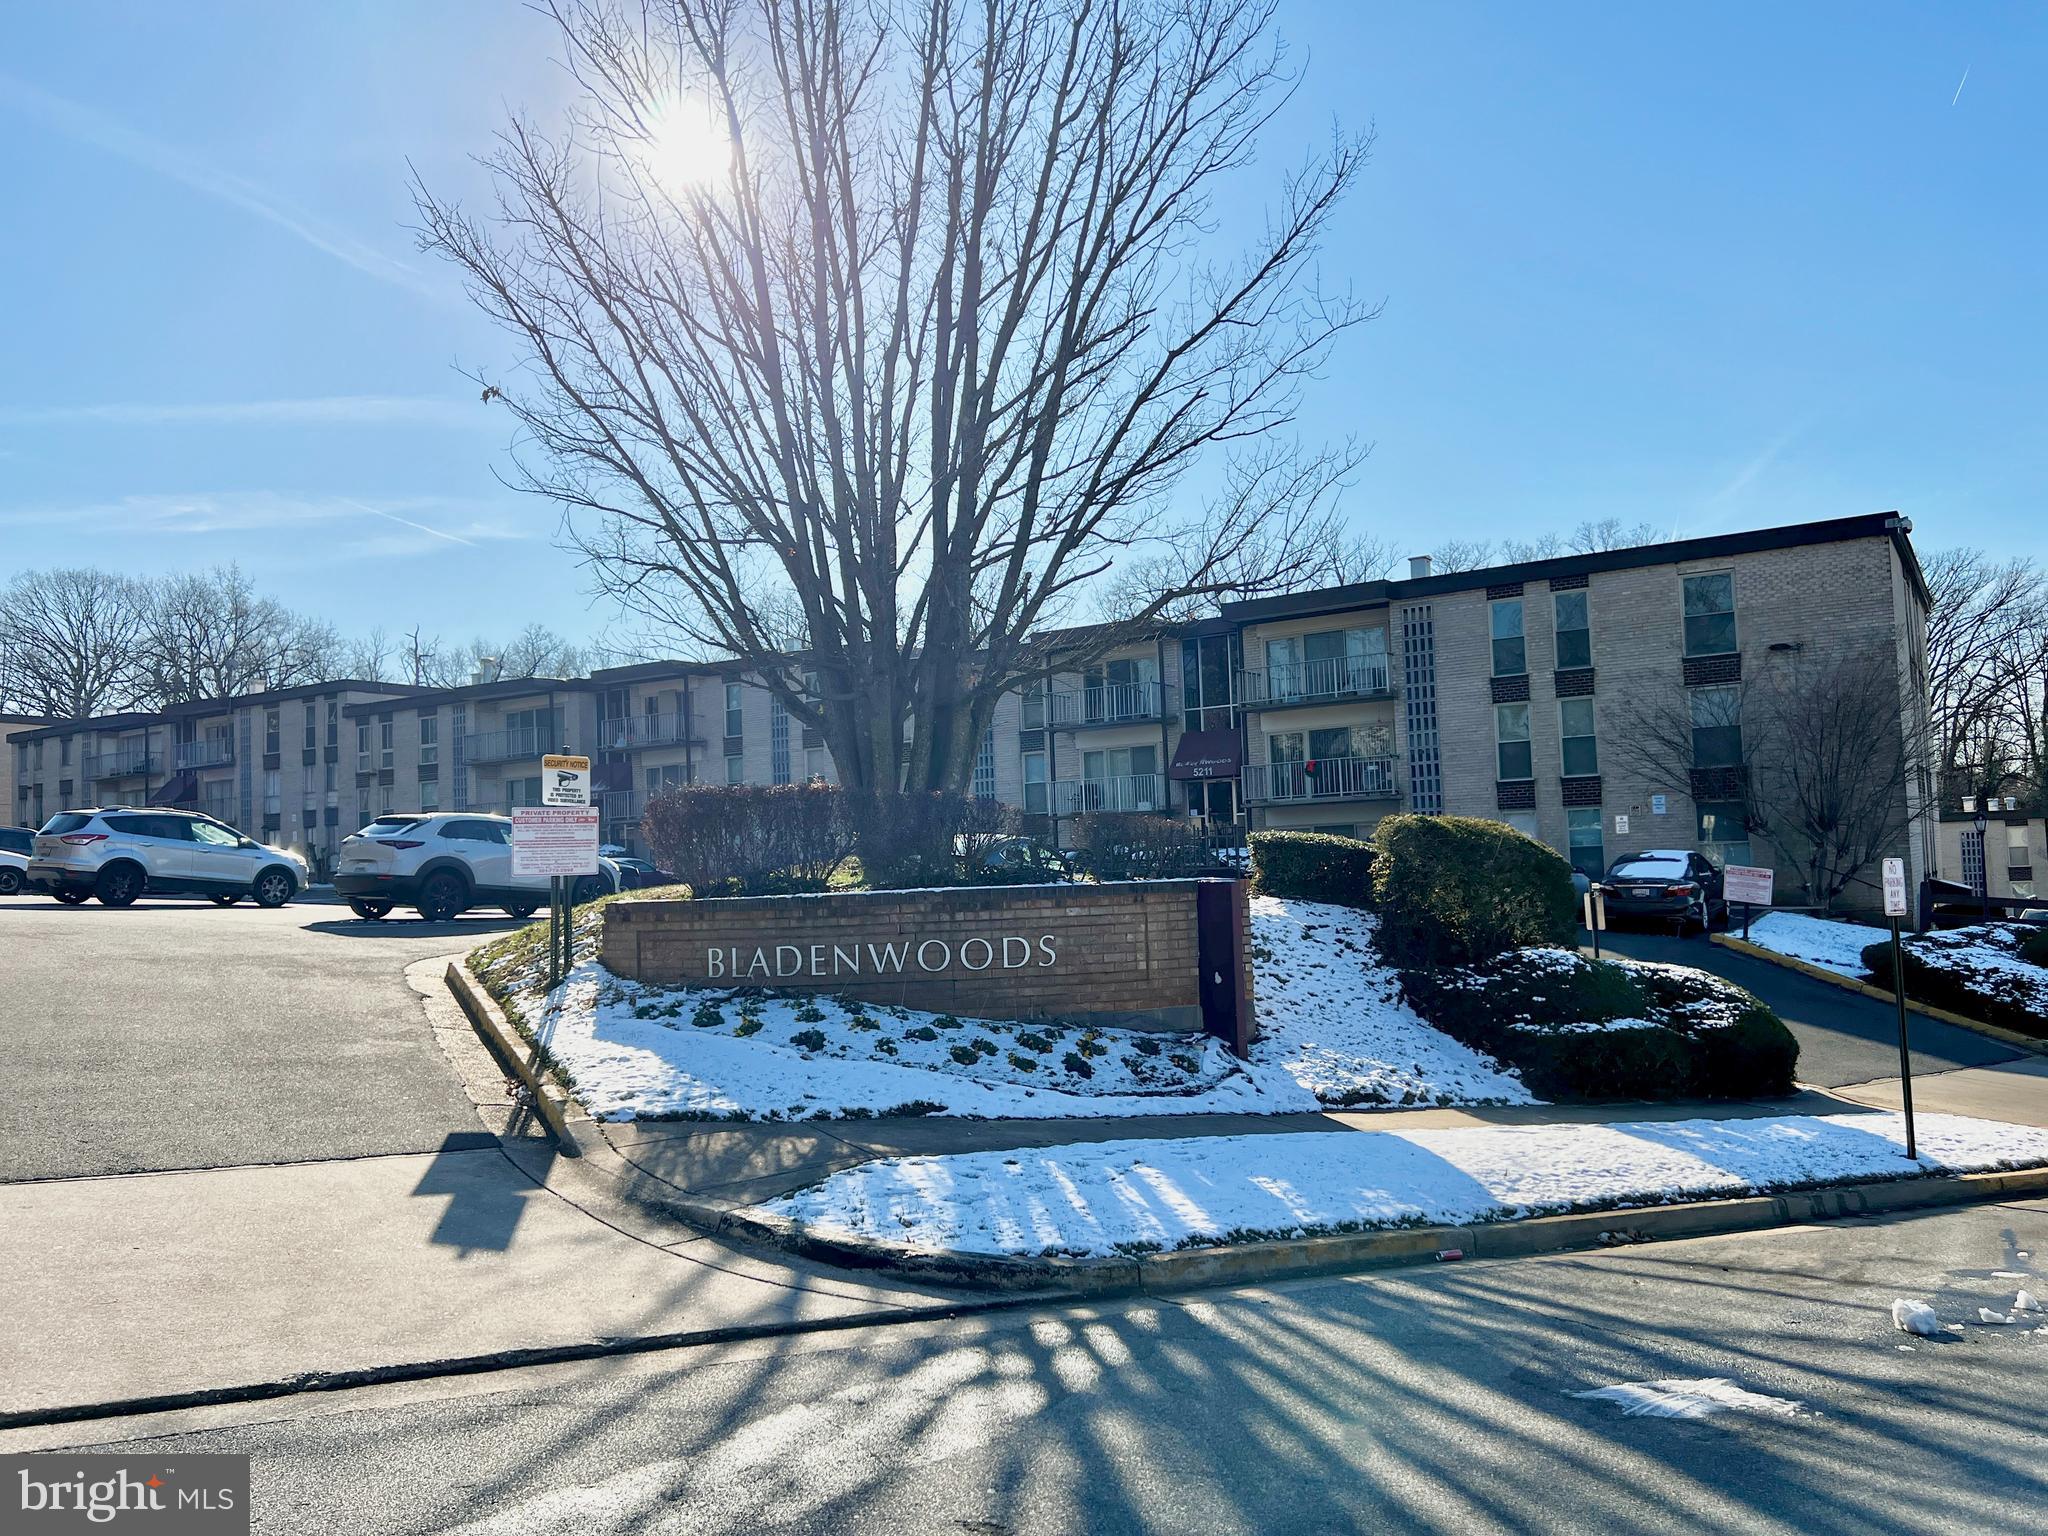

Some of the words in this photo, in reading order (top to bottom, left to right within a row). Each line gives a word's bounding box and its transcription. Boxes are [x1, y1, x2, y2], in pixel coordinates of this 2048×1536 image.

[544, 759, 569, 768] SECURITY
[570, 761, 588, 769] NOTICE
[1193, 767, 1213, 776] 5211
[1888, 864, 1897, 875] NO
[1884, 876, 1904, 888] PARKING
[1890, 889, 1900, 898] ANY
[707, 934, 1057, 979] BLADENWOODS
